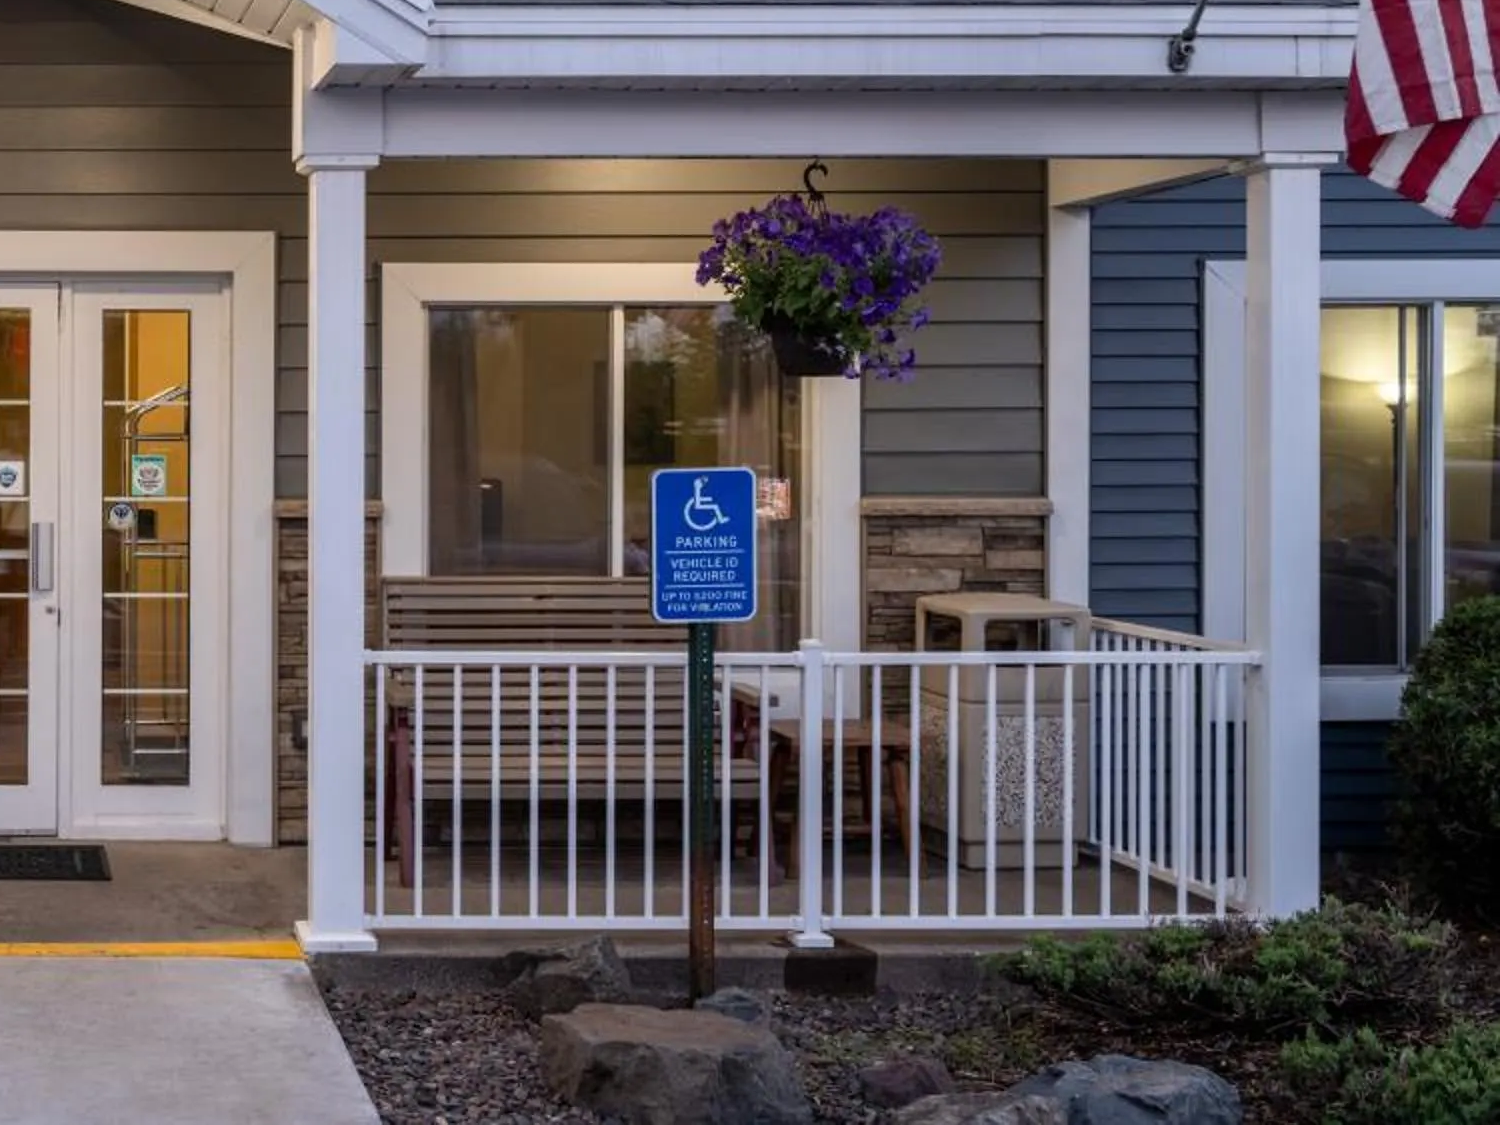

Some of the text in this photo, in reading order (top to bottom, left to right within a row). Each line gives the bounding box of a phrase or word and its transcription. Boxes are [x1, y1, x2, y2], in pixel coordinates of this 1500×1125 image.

[675, 536, 737, 548] PARKING
[670, 556, 739, 569] VEHICLE ID
[673, 570, 737, 582] REQUIRED
[661, 593, 677, 602] UP
[679, 592, 691, 601] TO
[724, 590, 748, 600] FINE
[667, 603, 687, 612] FOR
